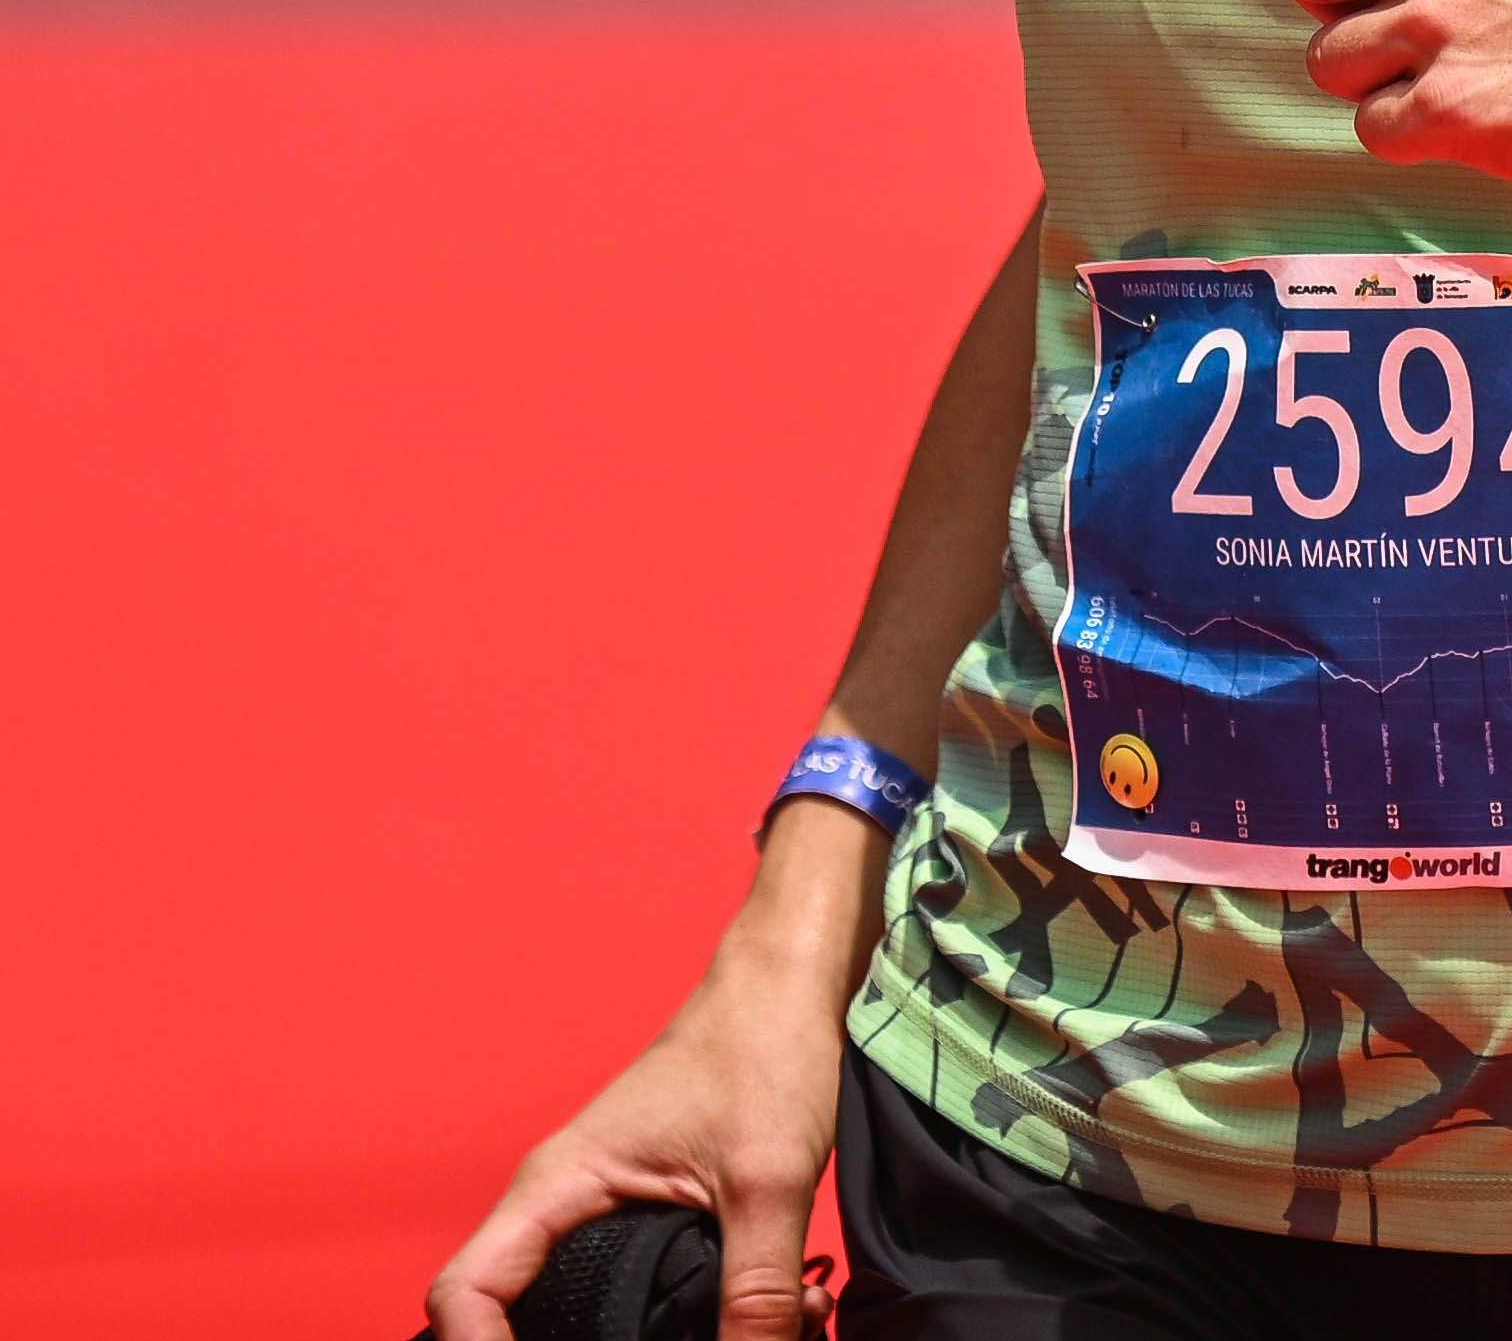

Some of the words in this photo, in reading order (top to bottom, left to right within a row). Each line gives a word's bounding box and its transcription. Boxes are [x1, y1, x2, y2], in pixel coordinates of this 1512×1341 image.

[1181, 283, 1196, 299] DE
[1199, 283, 1220, 299] LAS
[1223, 283, 1254, 299] TUCAS
[1287, 284, 1338, 296] SCARPA
[1215, 536, 1293, 567] SONIA
[1300, 532, 1409, 568] MARTÍN
